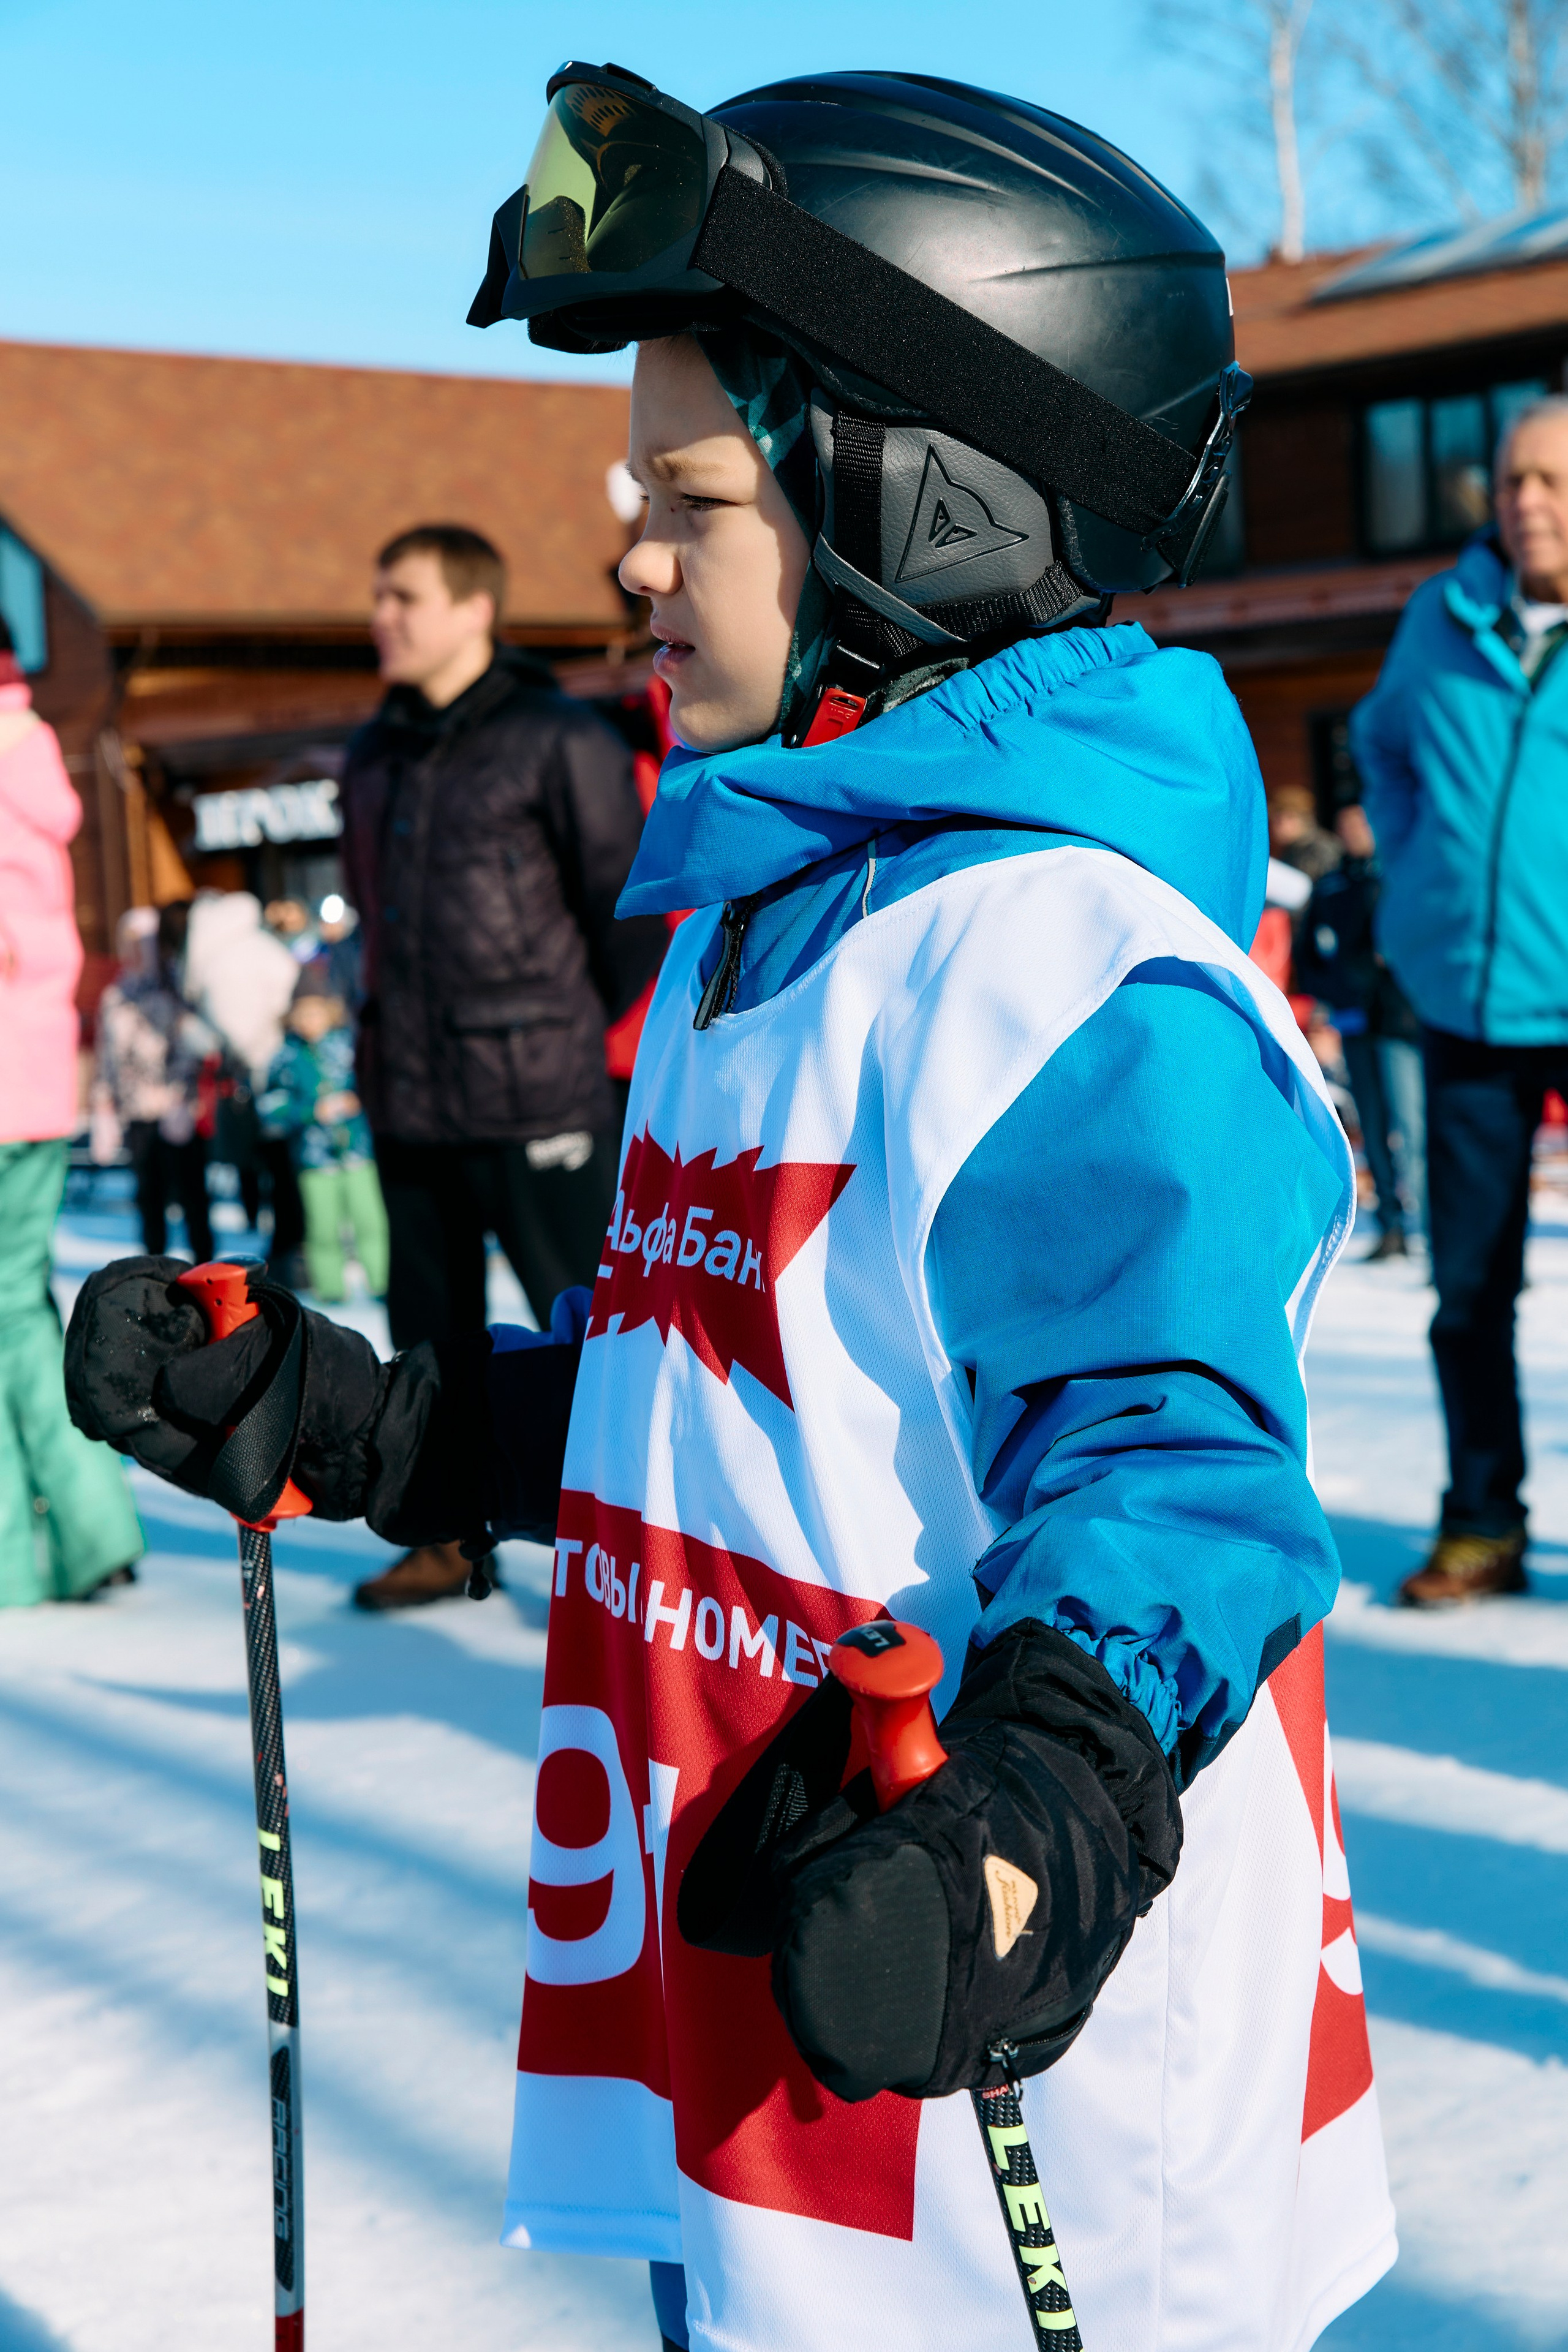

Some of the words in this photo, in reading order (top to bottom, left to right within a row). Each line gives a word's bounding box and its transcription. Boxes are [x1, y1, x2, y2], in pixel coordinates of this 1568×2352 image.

[555, 1537, 643, 1624] ТОВЫ
[982, 2083, 1009, 2100] SHA
[987, 2123, 1077, 2330] LEKI
